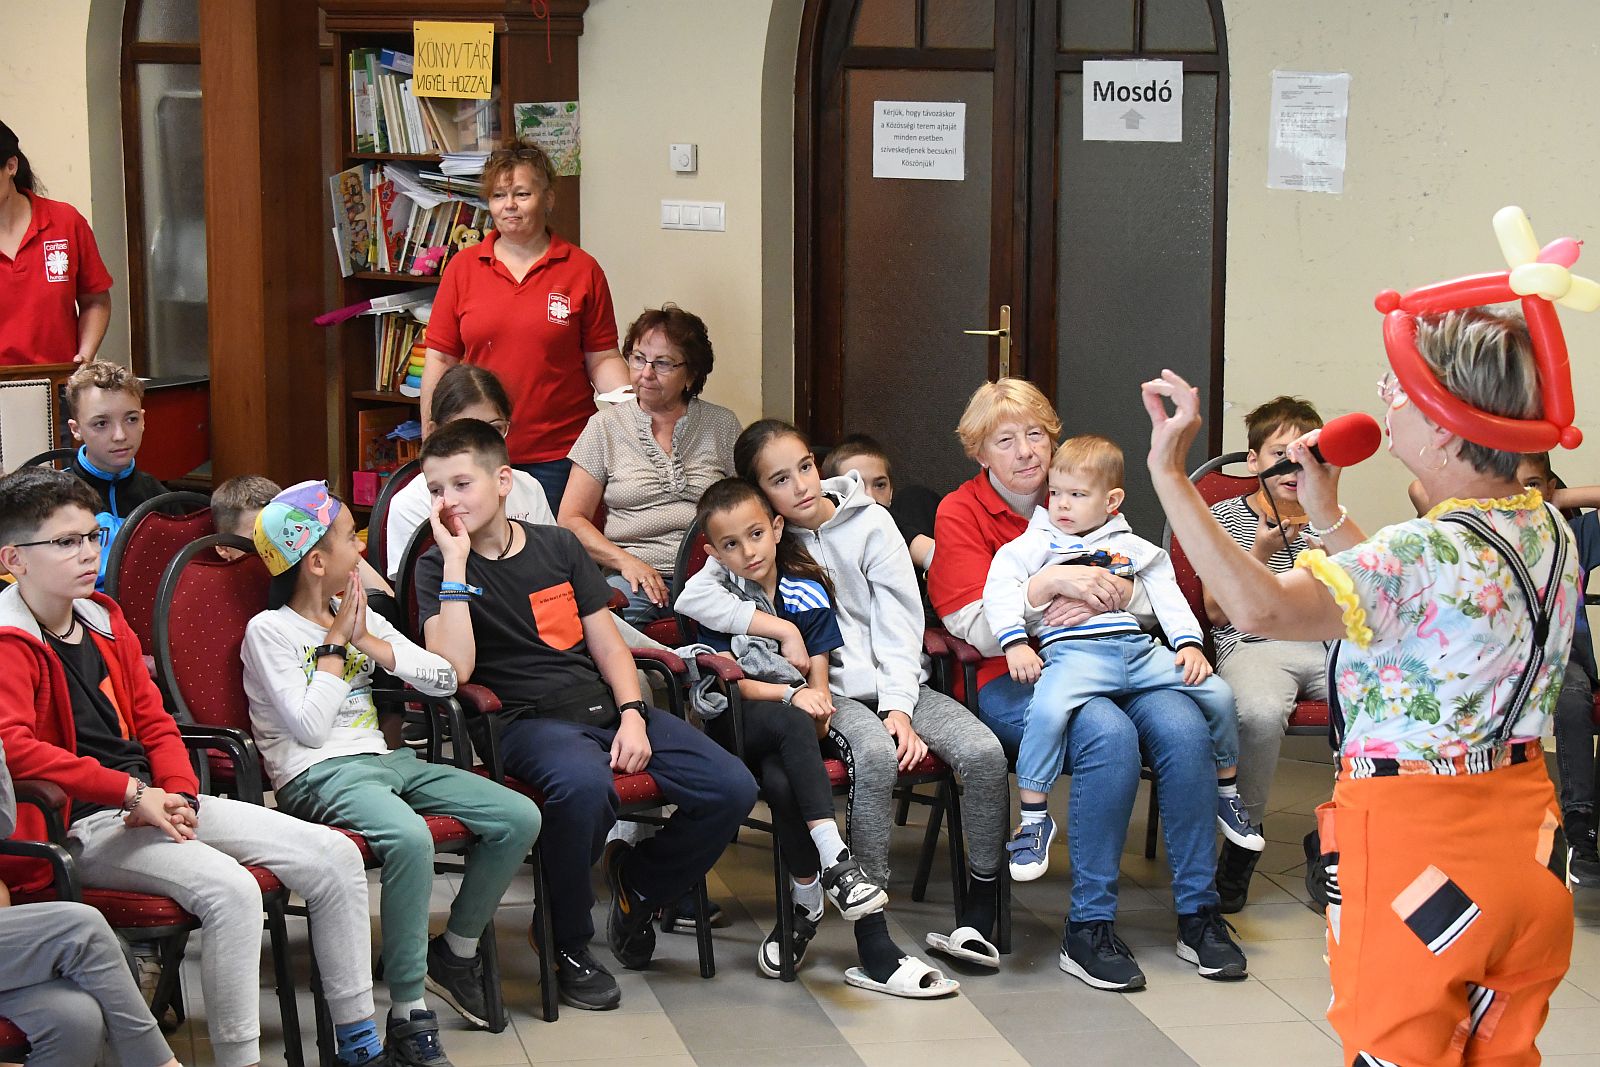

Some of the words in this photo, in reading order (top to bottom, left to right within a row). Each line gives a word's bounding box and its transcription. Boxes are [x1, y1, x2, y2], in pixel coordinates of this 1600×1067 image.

[418, 38, 491, 70] KÖNYVTÁR
[1093, 80, 1172, 103] Mosdó
[906, 110, 920, 118] hogy
